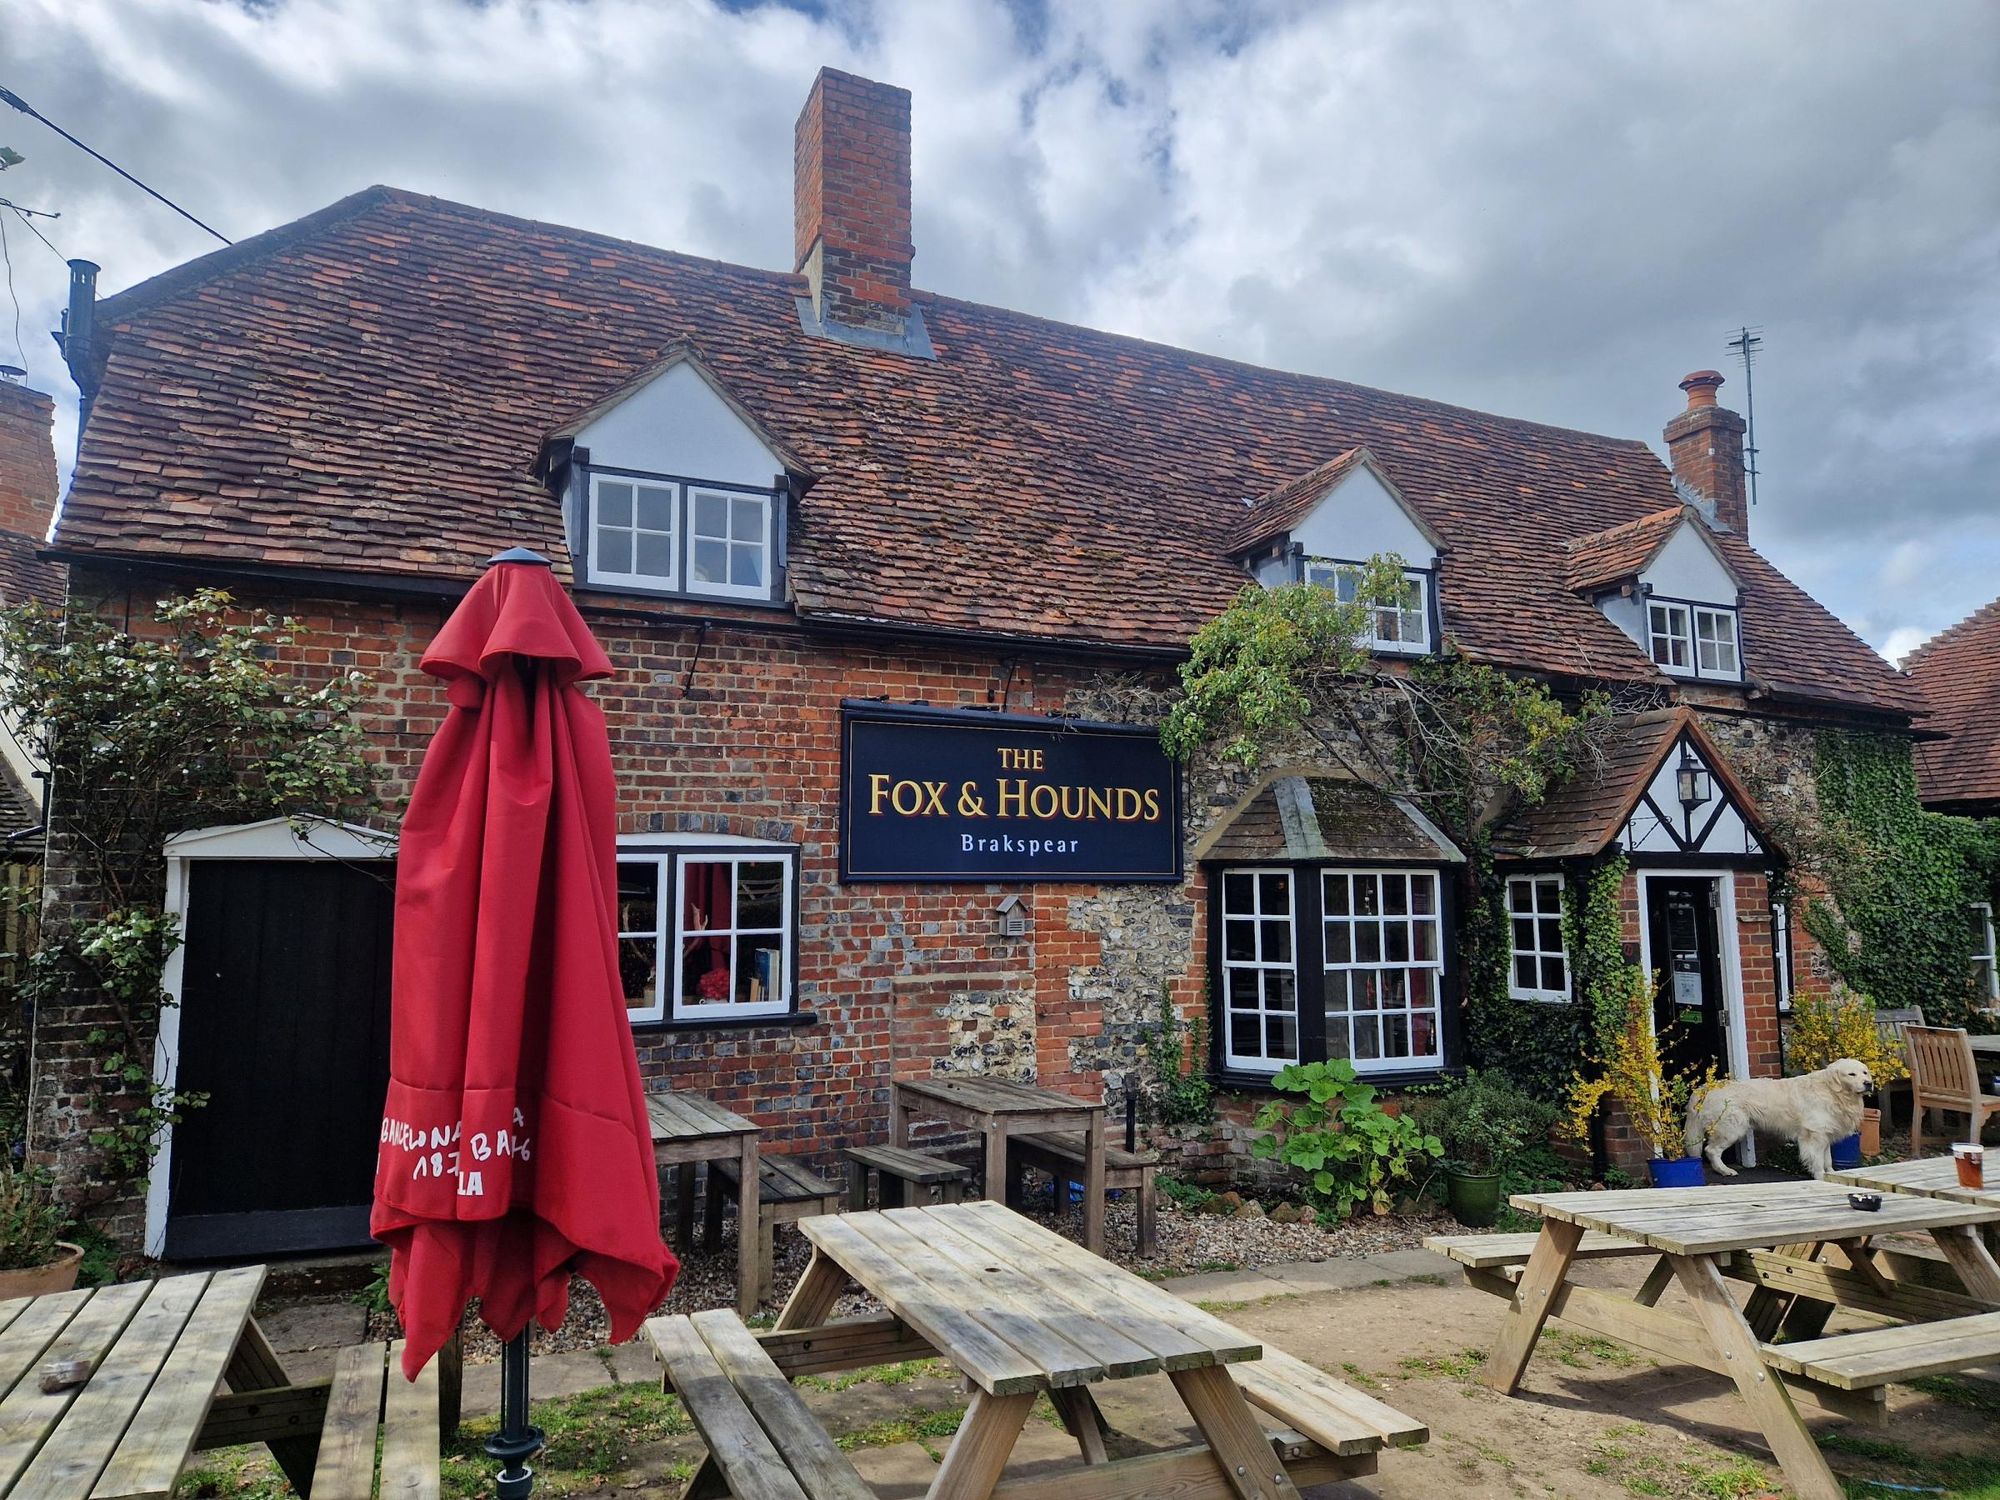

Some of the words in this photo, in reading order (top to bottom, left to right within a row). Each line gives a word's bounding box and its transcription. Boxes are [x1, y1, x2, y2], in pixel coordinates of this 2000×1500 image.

[997, 748, 1044, 770] THE
[957, 781, 989, 818] &
[961, 833, 1080, 857] Brakspear
